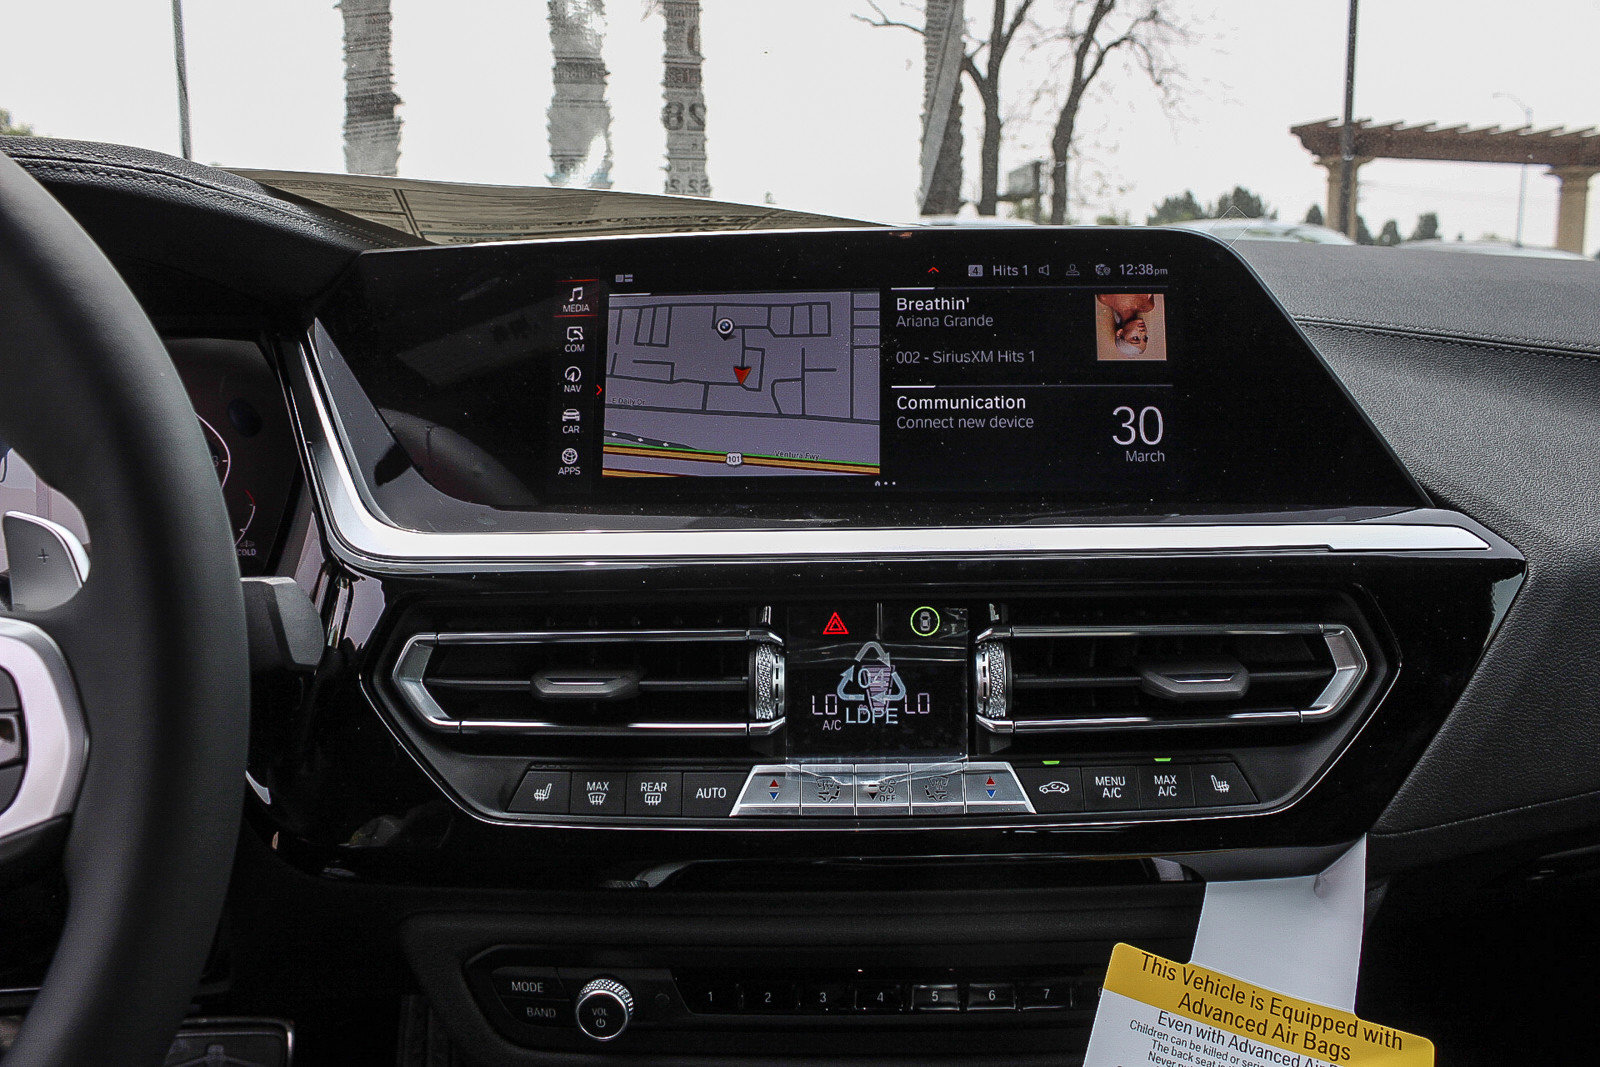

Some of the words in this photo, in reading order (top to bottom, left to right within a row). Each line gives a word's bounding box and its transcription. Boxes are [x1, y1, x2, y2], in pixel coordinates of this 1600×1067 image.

[992, 264, 1019, 276] Hits
[1022, 264, 1029, 276] 1
[562, 303, 590, 313] MEDIA
[896, 297, 970, 311] Breathin'
[896, 315, 940, 327] Ariana
[944, 314, 994, 327] Grande
[564, 343, 585, 353] COM
[896, 350, 920, 364] 002
[932, 350, 994, 363] SiriusXM
[997, 350, 1025, 363] Hits
[1029, 350, 1036, 363] 1
[563, 384, 582, 393] NAV
[896, 395, 1026, 410] Communication
[896, 416, 954, 429] Connect
[958, 418, 986, 429] new
[989, 415, 1035, 429] device
[1112, 406, 1164, 446] 30
[562, 424, 580, 434] CAR
[728, 455, 741, 463] 101
[1125, 450, 1166, 463] March
[558, 466, 581, 476] APPS
[811, 694, 838, 715] LO
[904, 692, 931, 714] LO
[845, 707, 899, 724] LDPE
[822, 719, 842, 731] A/C
[1095, 776, 1126, 787] MENU
[1154, 775, 1178, 785] MAX
[586, 781, 609, 792] MAX
[640, 781, 668, 793] REAR
[1157, 785, 1178, 797] A/C
[695, 787, 727, 799] AUTO
[878, 793, 897, 803] OFF
[1102, 787, 1122, 799] A/C
[511, 981, 545, 993] MODE
[707, 991, 714, 1002] 1
[764, 992, 772, 1003] 2
[819, 992, 827, 1003] 3
[876, 992, 885, 1003] 4
[931, 990, 939, 1002] 5
[988, 989, 996, 1000] 6
[1043, 988, 1050, 1000] 7
[1141, 952, 1177, 981] This
[1181, 966, 1246, 1004] Vehicle
[1250, 990, 1265, 1011] is
[1269, 996, 1359, 1039] Equipped
[1363, 1026, 1403, 1051] with
[526, 1007, 557, 1018] BAND
[591, 1007, 608, 1016] VOL
[1177, 992, 1267, 1037] Advanced
[1271, 1019, 1299, 1046] Air
[1303, 1031, 1351, 1061] Bags
[1129, 1019, 1169, 1042] Children
[1170, 1035, 1188, 1048] can
[1189, 1039, 1201, 1052] be
[1203, 1044, 1228, 1062] killed
[1230, 1054, 1241, 1065] or
[1157, 1010, 1192, 1035] Even
[1196, 1025, 1226, 1046] with
[1228, 1034, 1301, 1067] Advanced
[1151, 1038, 1170, 1054] The
[1171, 1046, 1194, 1062] back
[1147, 1050, 1177, 1067] Never
